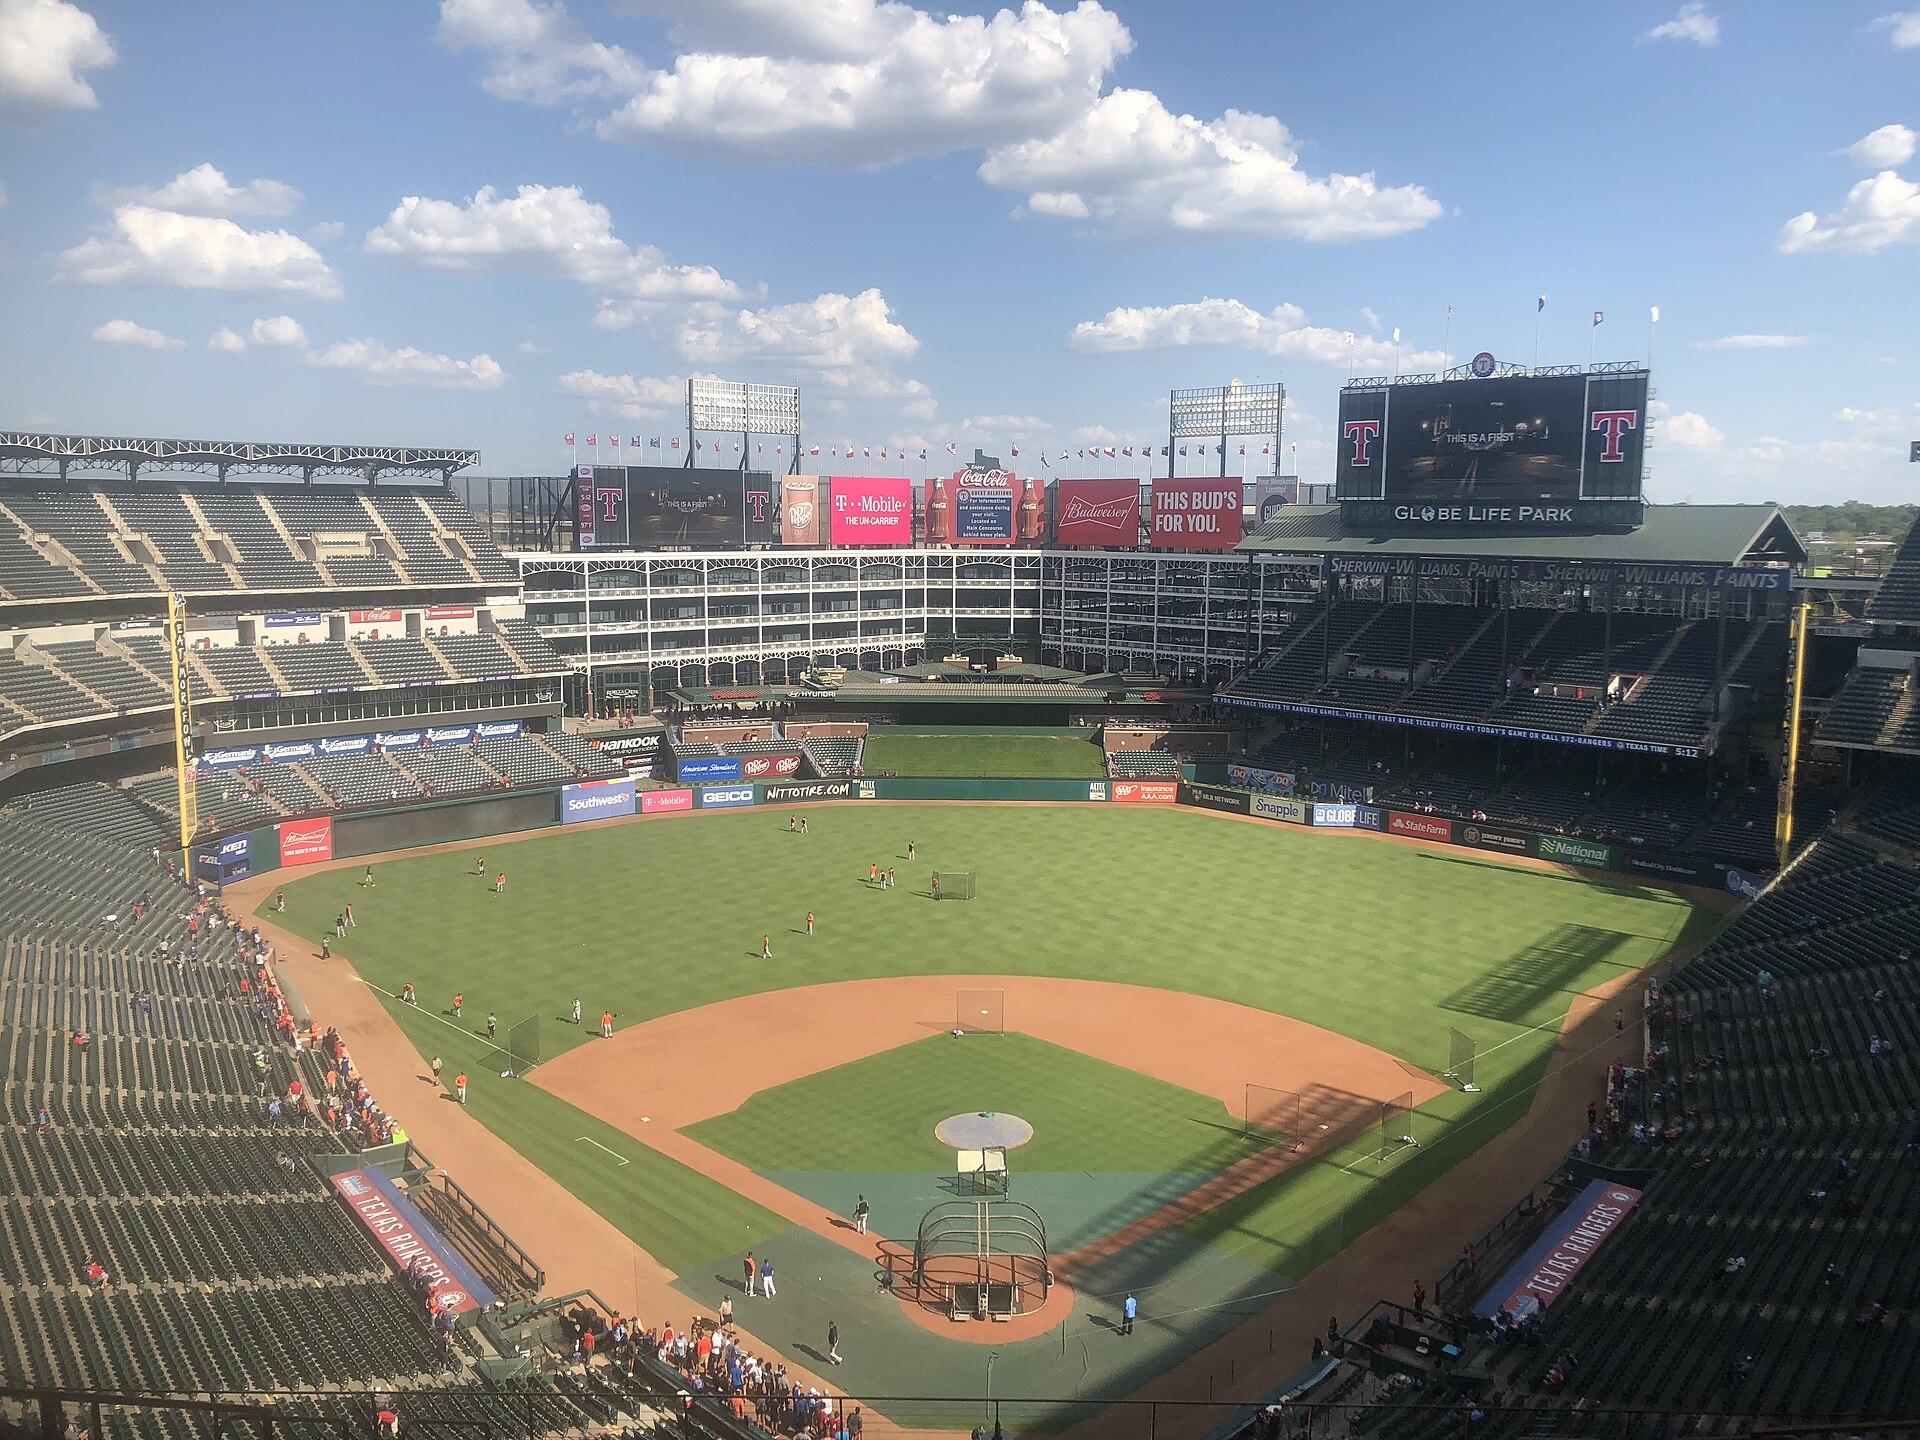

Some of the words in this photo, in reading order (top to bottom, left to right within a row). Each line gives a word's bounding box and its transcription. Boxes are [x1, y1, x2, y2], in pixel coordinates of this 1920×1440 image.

[1344, 420, 1380, 467] T
[1447, 434, 1467, 443] THIS
[1468, 434, 1478, 443] IS
[1479, 434, 1486, 442] A
[1488, 432, 1515, 442] FIRST
[1591, 410, 1637, 463] T
[597, 488, 622, 522] T
[747, 491, 769, 522] T
[1156, 491, 1188, 510] THIS
[1192, 491, 1237, 510] BUD'S
[1065, 501, 1129, 519] Budweiser
[1394, 506, 1462, 522] GLOBE
[1469, 506, 1511, 521] LIFE
[1519, 506, 1573, 521] PARK
[845, 516, 858, 525] THE
[860, 516, 899, 525] UN-CARRIER
[1155, 514, 1183, 532] FOR
[1187, 514, 1221, 532] YOU.
[176, 623, 184, 660] EAT
[179, 667, 188, 704] MOR
[1233, 699, 1256, 707] ADVANCE
[1258, 702, 1281, 710] TICKETS
[1292, 706, 1318, 714] RANGERS
[1378, 715, 1396, 723] FIRST
[1416, 720, 1439, 728] TICKET
[1441, 722, 1465, 731] OFFICE
[1477, 726, 1506, 735] TODAY'S
[1508, 729, 1527, 738] GAME
[1561, 735, 1612, 747] 972-RANGERS
[182, 711, 192, 761] FOWL
[610, 748, 632, 756] driving
[1626, 743, 1648, 751] TEXAS
[1650, 745, 1668, 753] TIME
[1675, 748, 1698, 758] 5:12
[681, 765, 708, 773] American
[1233, 768, 1247, 779] DQ
[1275, 776, 1290, 786] DQ
[703, 790, 753, 803] GEICO
[767, 783, 850, 799] NITTOTIRE.COM
[1202, 793, 1214, 801] MLB
[1215, 795, 1241, 806] NETWORK
[1330, 782, 1367, 800] Mitel
[568, 793, 623, 811] Southwest
[1256, 798, 1299, 818] Snapple
[1327, 809, 1356, 823] GLOBE
[1359, 811, 1378, 826] LIFE
[288, 833, 324, 843] Budweiser
[1555, 842, 1607, 861] National
[357, 1195, 403, 1234] TEXAS
[386, 1233, 450, 1287] RANGERS
[1527, 1252, 1580, 1294] TEXAS
[1563, 1204, 1622, 1254] RANGERS
